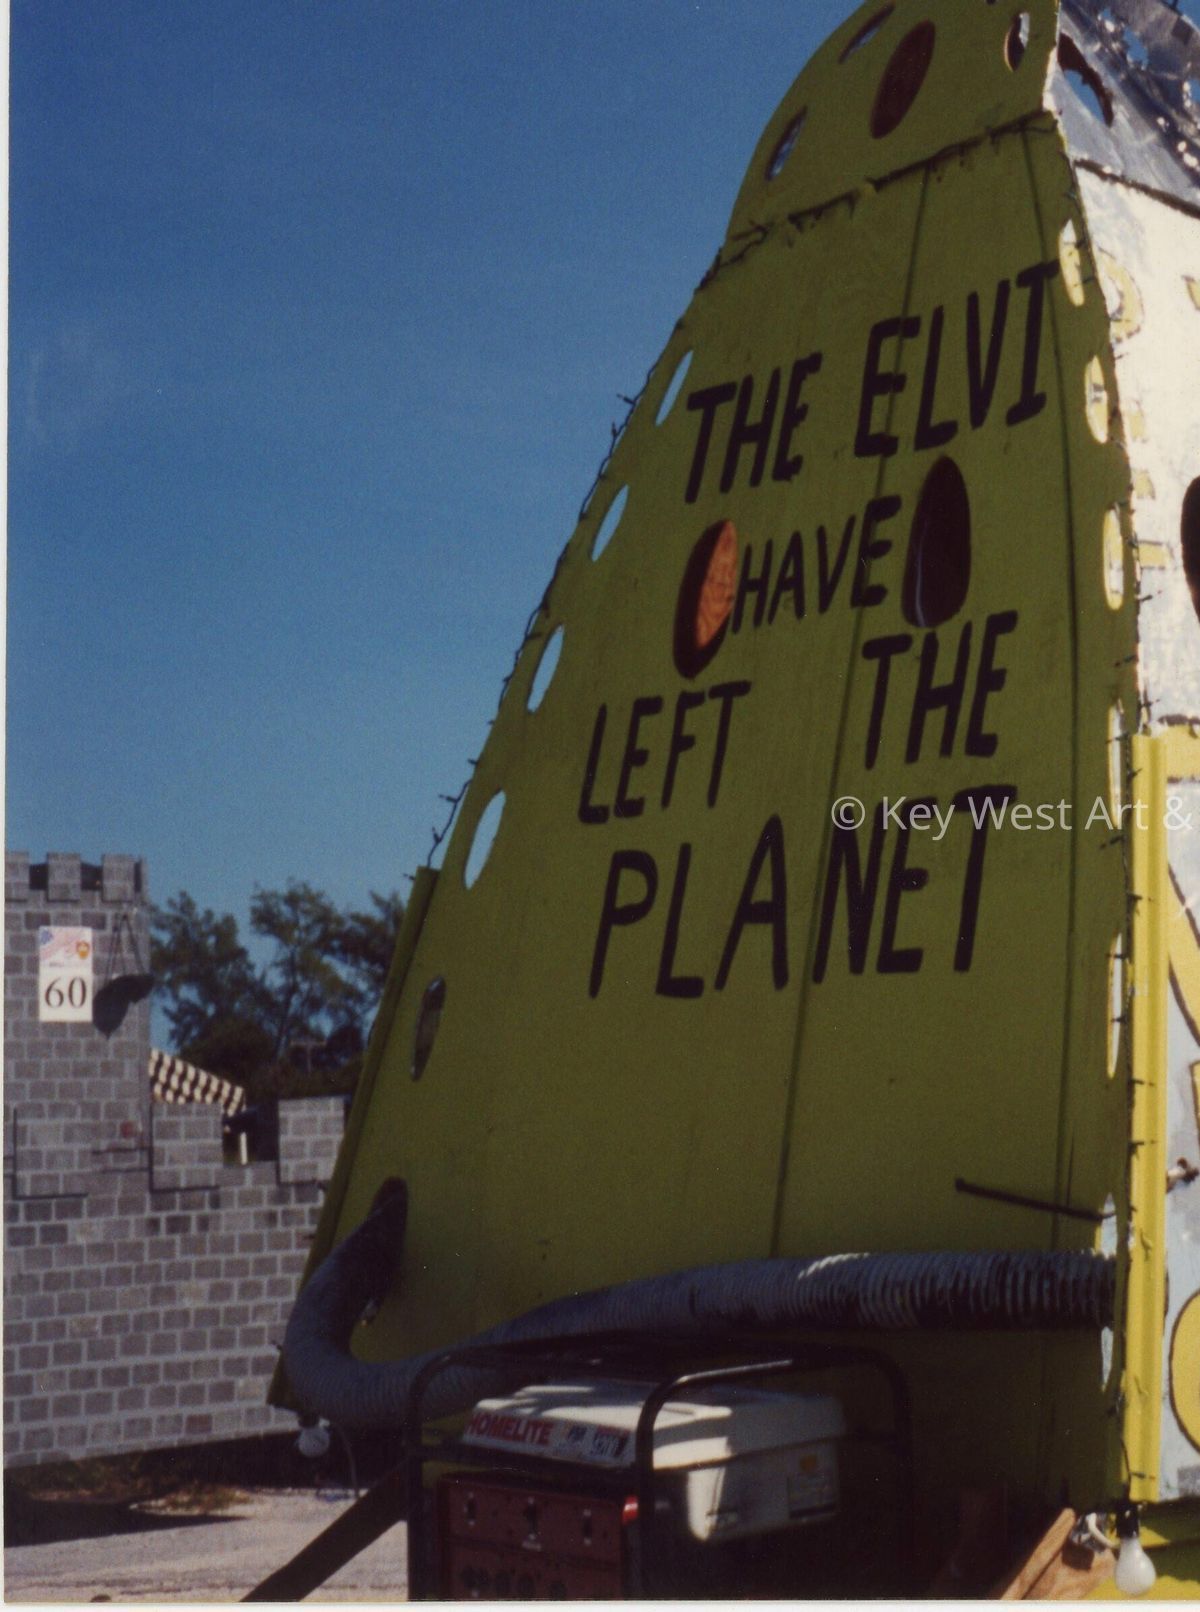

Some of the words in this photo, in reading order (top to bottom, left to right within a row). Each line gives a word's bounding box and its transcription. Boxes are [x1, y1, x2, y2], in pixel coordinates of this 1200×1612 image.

[684, 351, 823, 504] THE
[853, 258, 1061, 458] ELVI
[731, 494, 902, 635] HAVE
[578, 680, 753, 825] LEFT
[862, 610, 1019, 771] THE
[588, 784, 1019, 1000] PLANET
[44, 976, 87, 1009] 60
[464, 1411, 554, 1447] HOMELITE
